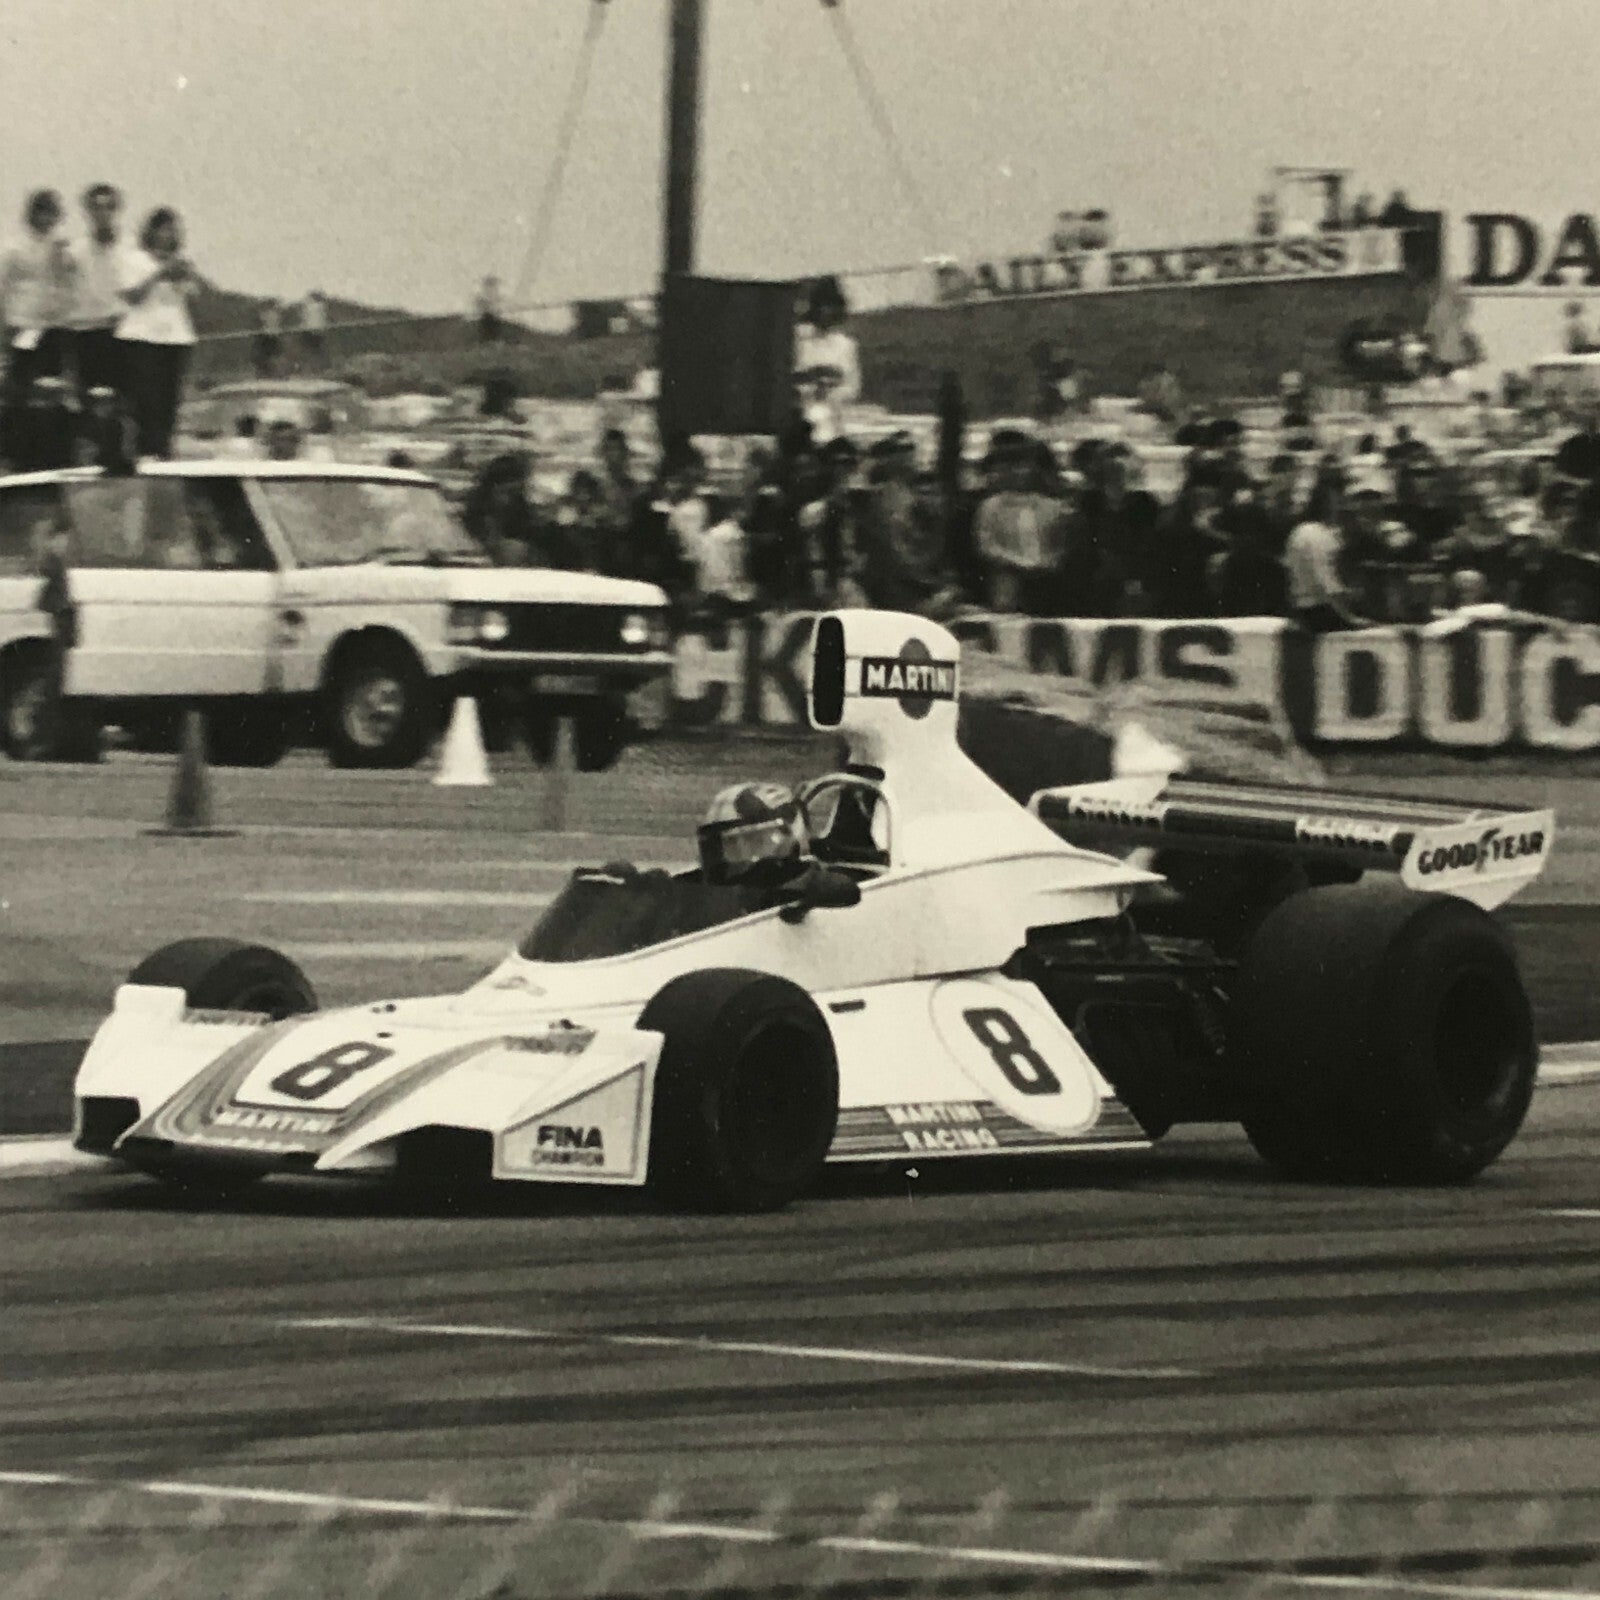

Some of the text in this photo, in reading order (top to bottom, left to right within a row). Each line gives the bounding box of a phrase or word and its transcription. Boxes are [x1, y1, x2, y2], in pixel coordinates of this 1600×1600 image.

[1109, 235, 1345, 287] EXPRESS
[1462, 211, 1600, 287] DA
[270, 1041, 394, 1100] 8
[961, 1006, 1062, 1096] 8
[537, 1125, 604, 1149] FINA
